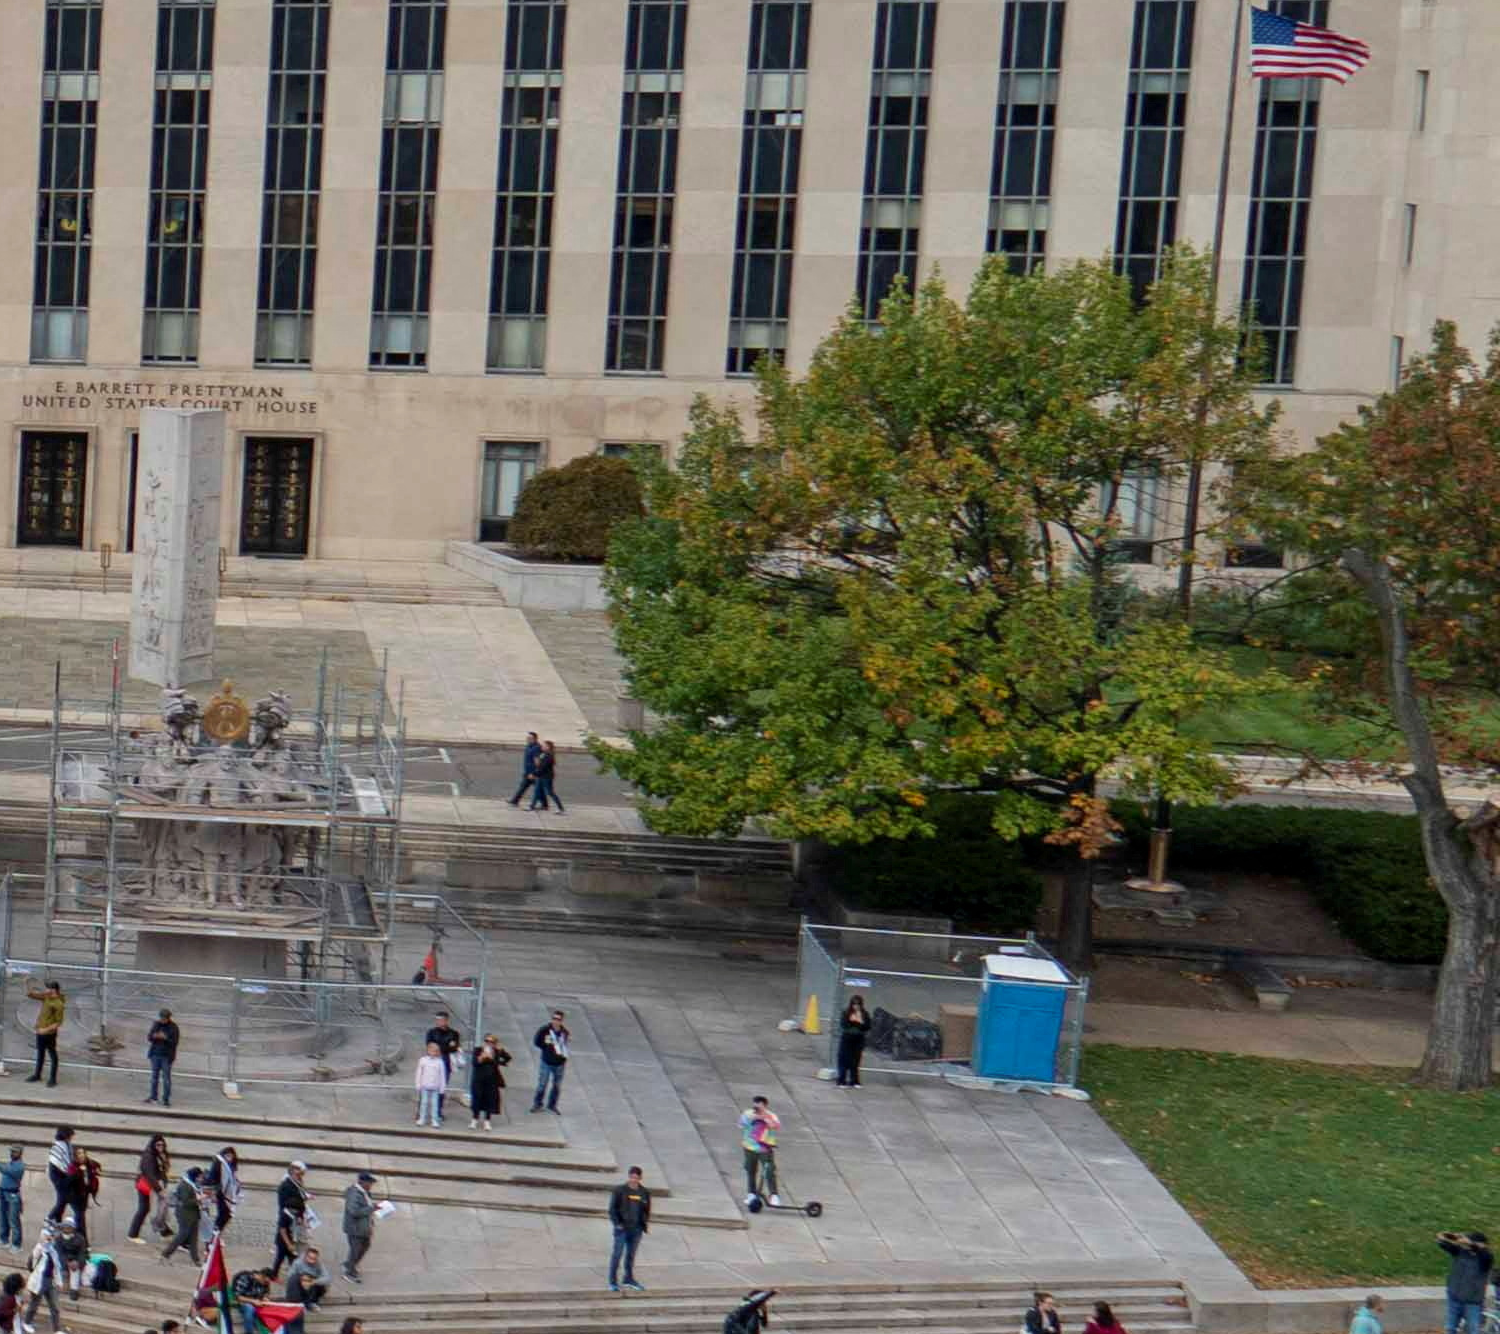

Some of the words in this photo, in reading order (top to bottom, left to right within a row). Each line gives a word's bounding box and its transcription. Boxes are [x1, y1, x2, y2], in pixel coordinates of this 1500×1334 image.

[55, 381, 67, 394] E.
[76, 381, 155, 395] BARRETT
[169, 383, 284, 398] PRETTYMAN
[22, 395, 92, 409] UNITED
[105, 397, 166, 410] STATES
[180, 399, 243, 413] COURT
[256, 401, 318, 414] HOUSE
